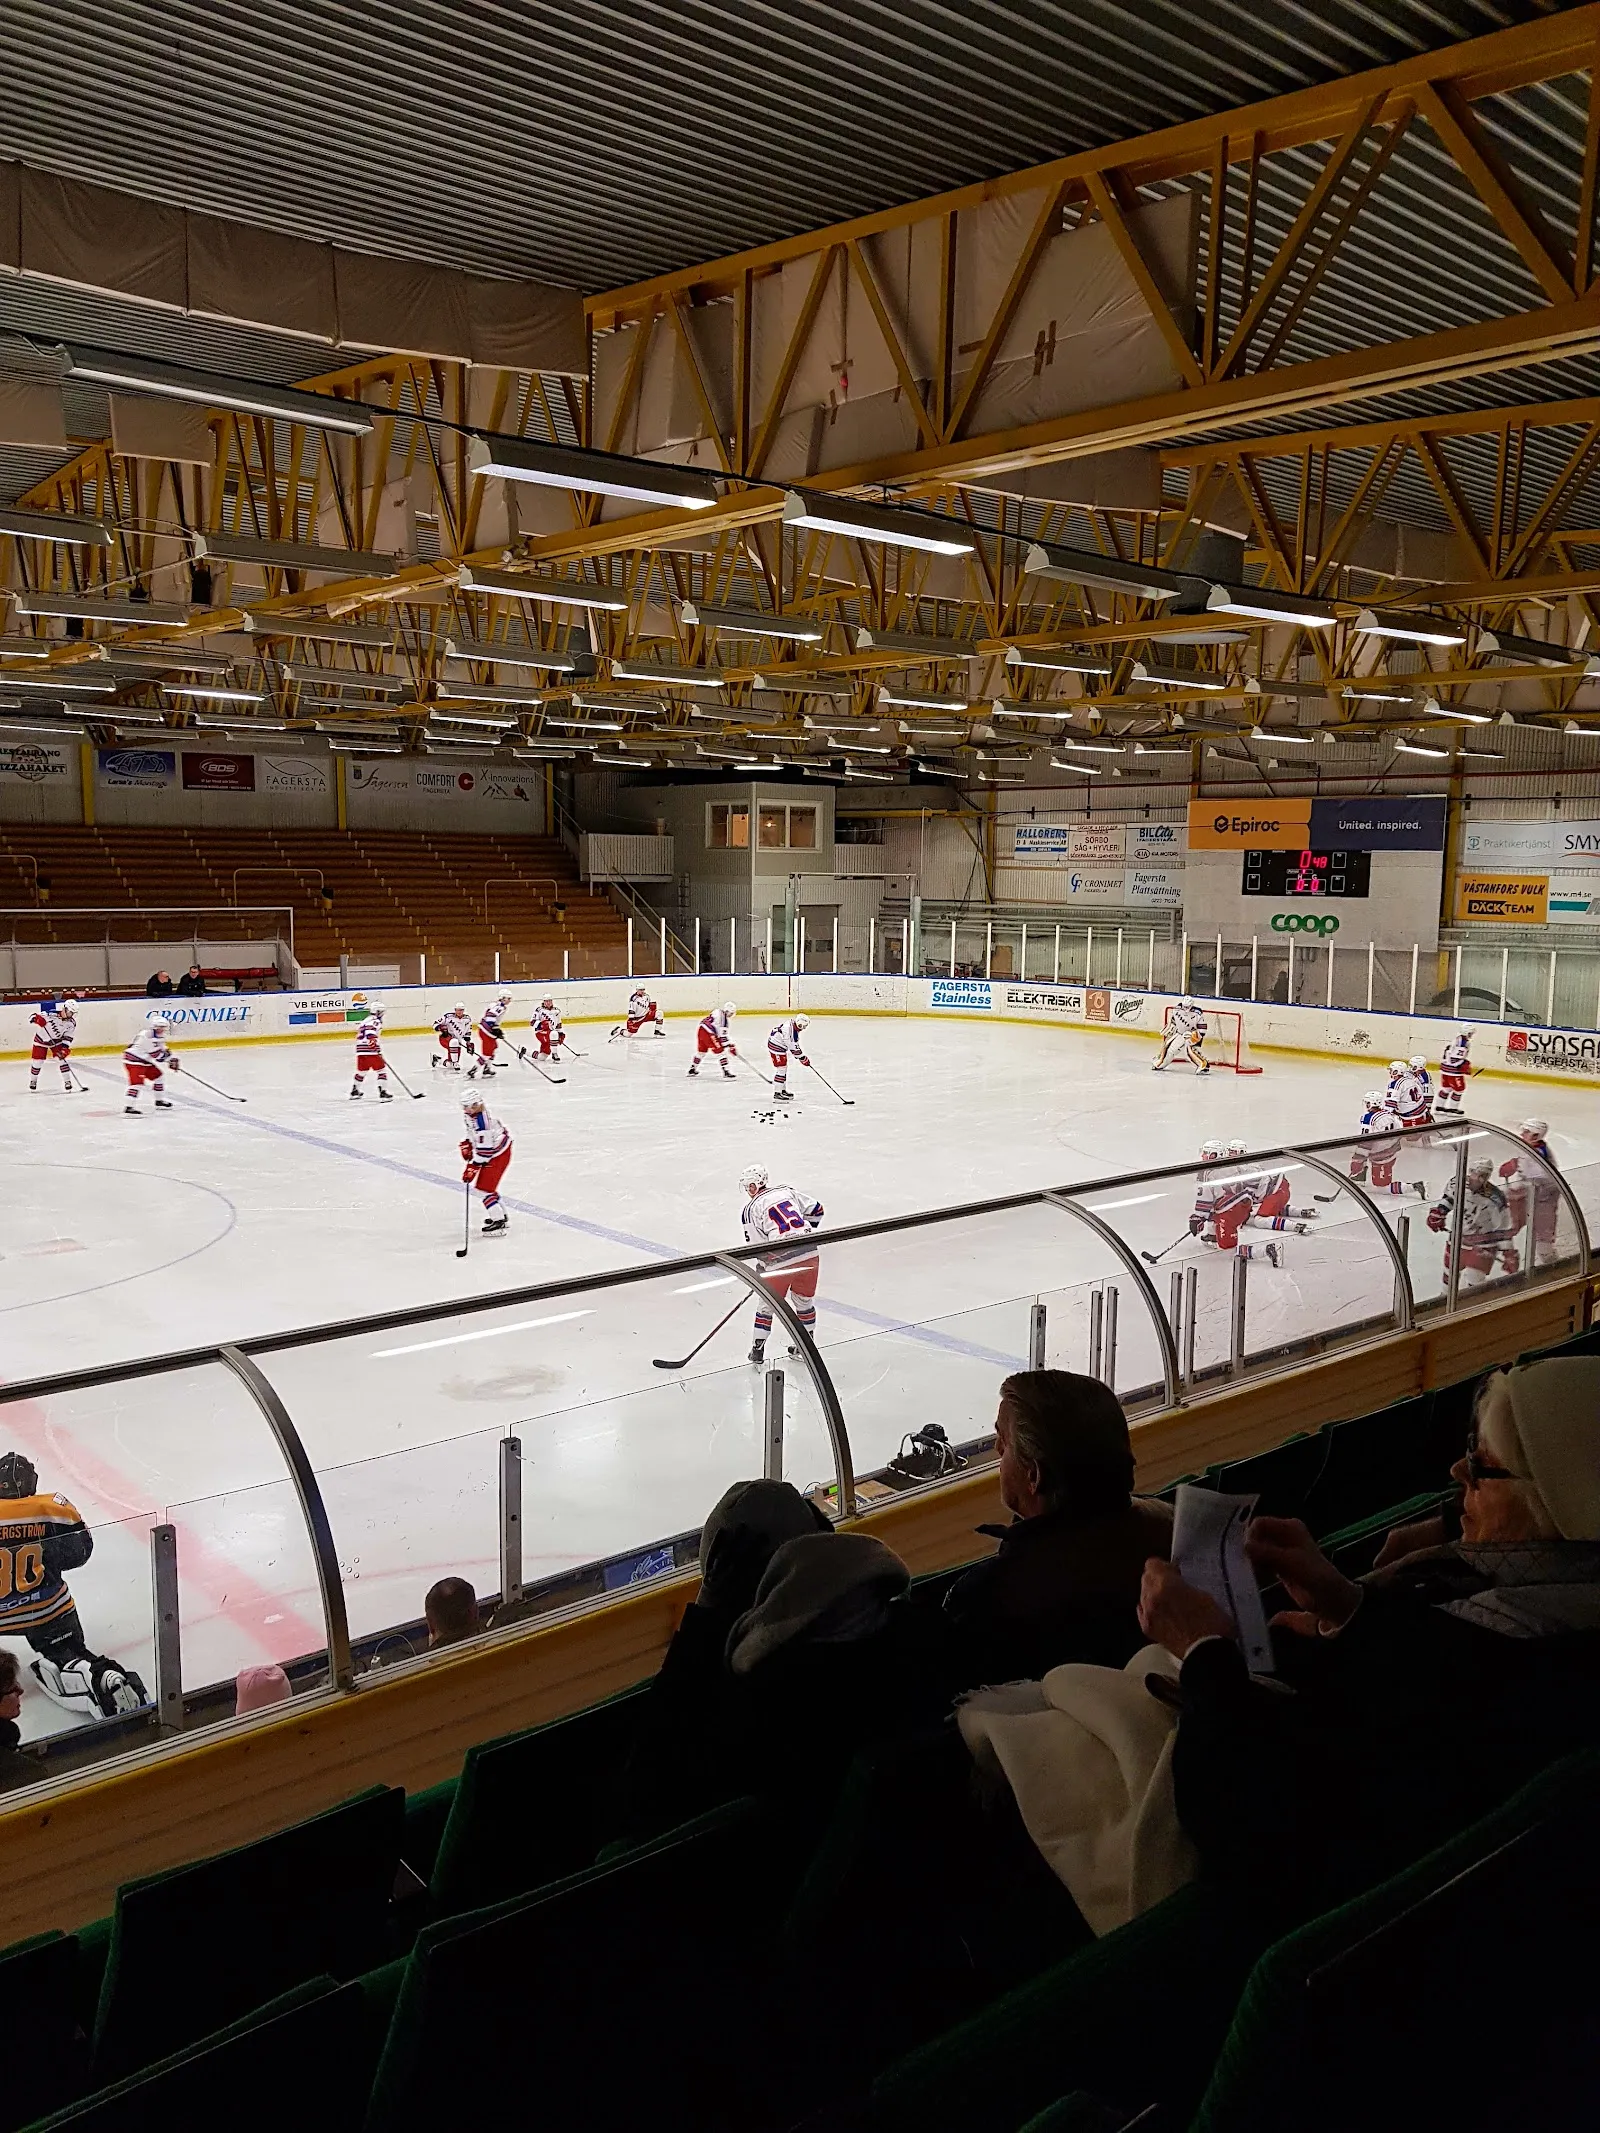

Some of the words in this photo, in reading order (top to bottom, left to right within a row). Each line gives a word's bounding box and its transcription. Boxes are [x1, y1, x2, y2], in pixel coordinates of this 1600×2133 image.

[266, 775, 326, 787] FAGERSTA
[416, 773, 456, 788] COMFORT
[1232, 816, 1280, 835] Epiroc
[1338, 820, 1374, 831] United.
[1377, 820, 1422, 832] inspired.
[1016, 829, 1067, 839] HALLGRENS
[1074, 843, 1088, 851] SÅG
[1484, 839, 1551, 850] Praktikertjänst
[1313, 856, 1328, 869] 48
[1084, 880, 1124, 888] CRONIMET
[1134, 872, 1166, 884] Fagersta
[1131, 885, 1182, 898] Plattsättning
[1463, 879, 1519, 895] VÄSTANFORS
[1520, 884, 1545, 896] VULK
[1550, 890, 1592, 898] www.m4.se
[1471, 900, 1501, 913] DÄCK
[1505, 903, 1535, 914] TEAM
[1271, 914, 1340, 938] coop
[932, 982, 991, 993] FAGERSTA
[294, 1001, 308, 1009] VB
[310, 1000, 345, 1008] ENERGI
[932, 992, 992, 1005] Stainless
[1527, 1033, 1600, 1058] SYNSA
[1534, 1055, 1588, 1069] FAGERSTA
[768, 1200, 805, 1235] 15
